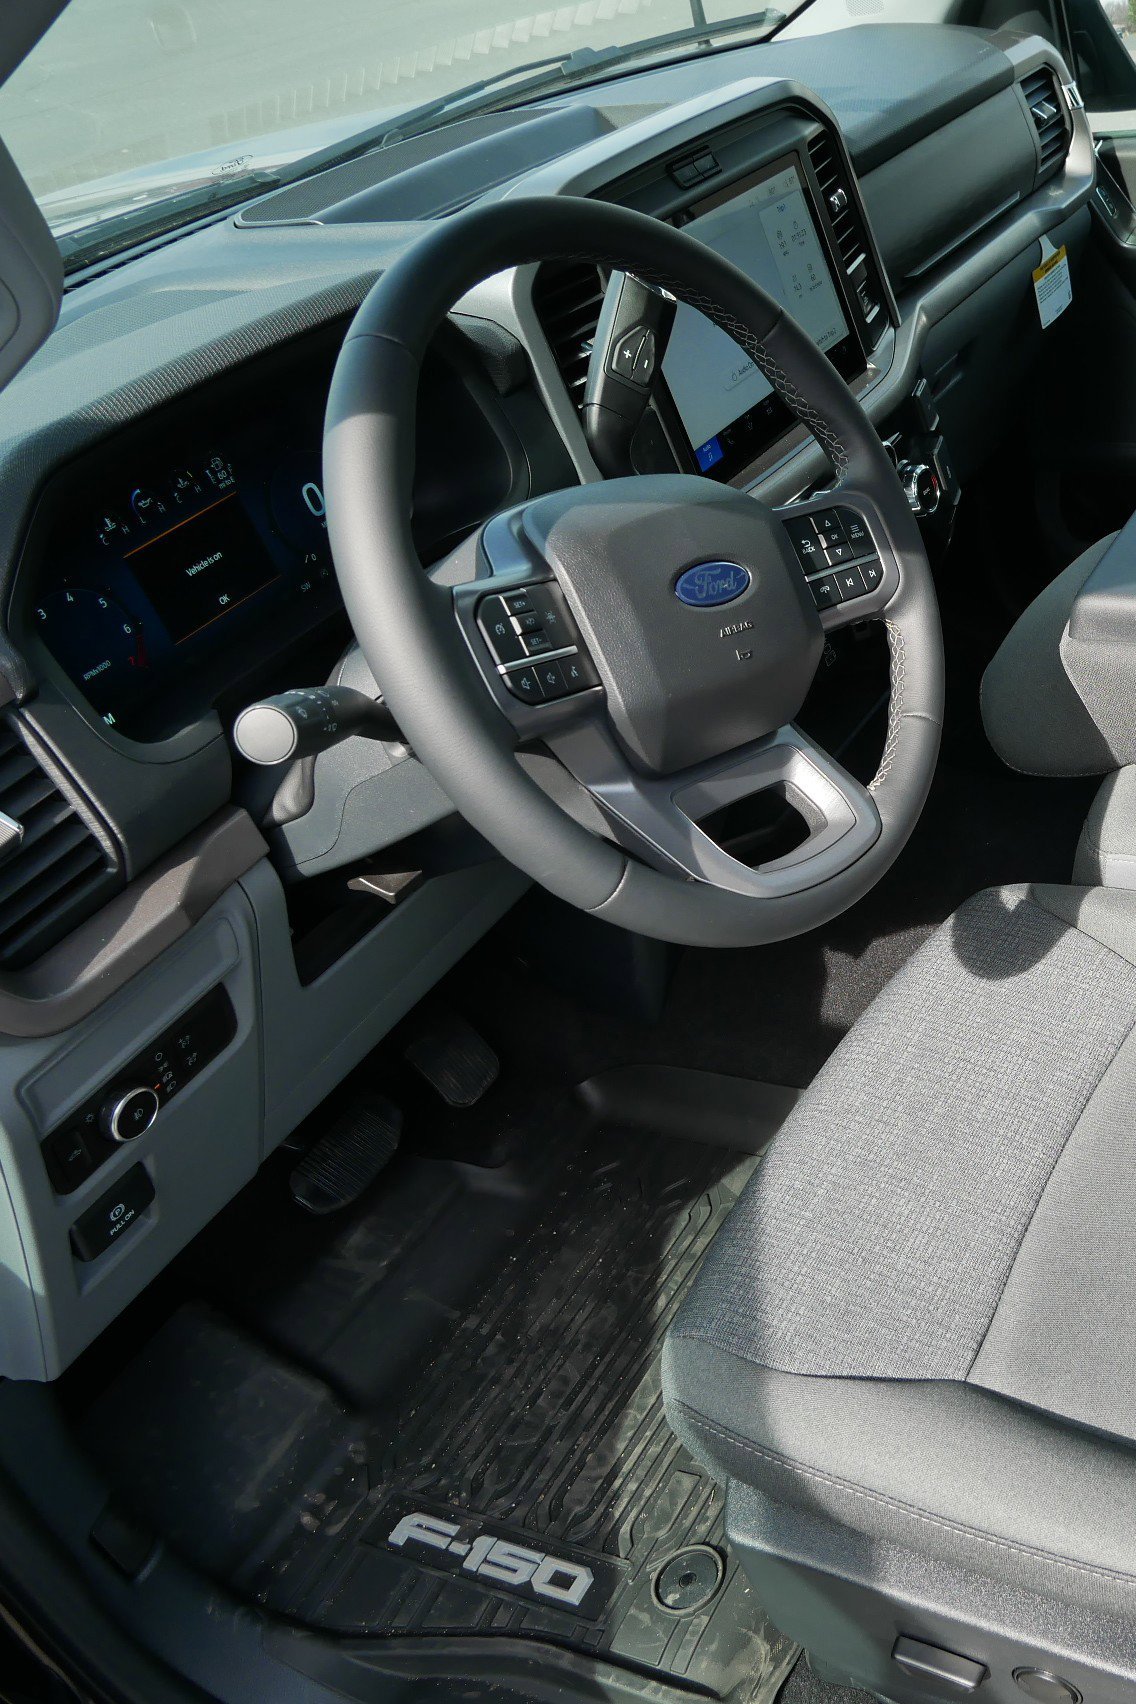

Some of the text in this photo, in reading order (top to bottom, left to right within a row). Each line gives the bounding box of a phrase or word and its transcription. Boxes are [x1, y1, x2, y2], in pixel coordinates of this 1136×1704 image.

[302, 482, 326, 517] 0
[802, 546, 816, 554] BACK
[185, 560, 209, 577] Vehicle
[213, 552, 223, 561] on
[690, 567, 740, 599] Ford
[66, 592, 74, 602] 4
[98, 597, 108, 609] 5
[219, 593, 230, 605] OK
[37, 608, 47, 620] 3
[123, 623, 132, 634] 6
[719, 620, 754, 638] AIRBAG
[102, 712, 116, 725] M
[110, 1209, 135, 1236] PULL ON
[388, 1511, 594, 1606] F-150
